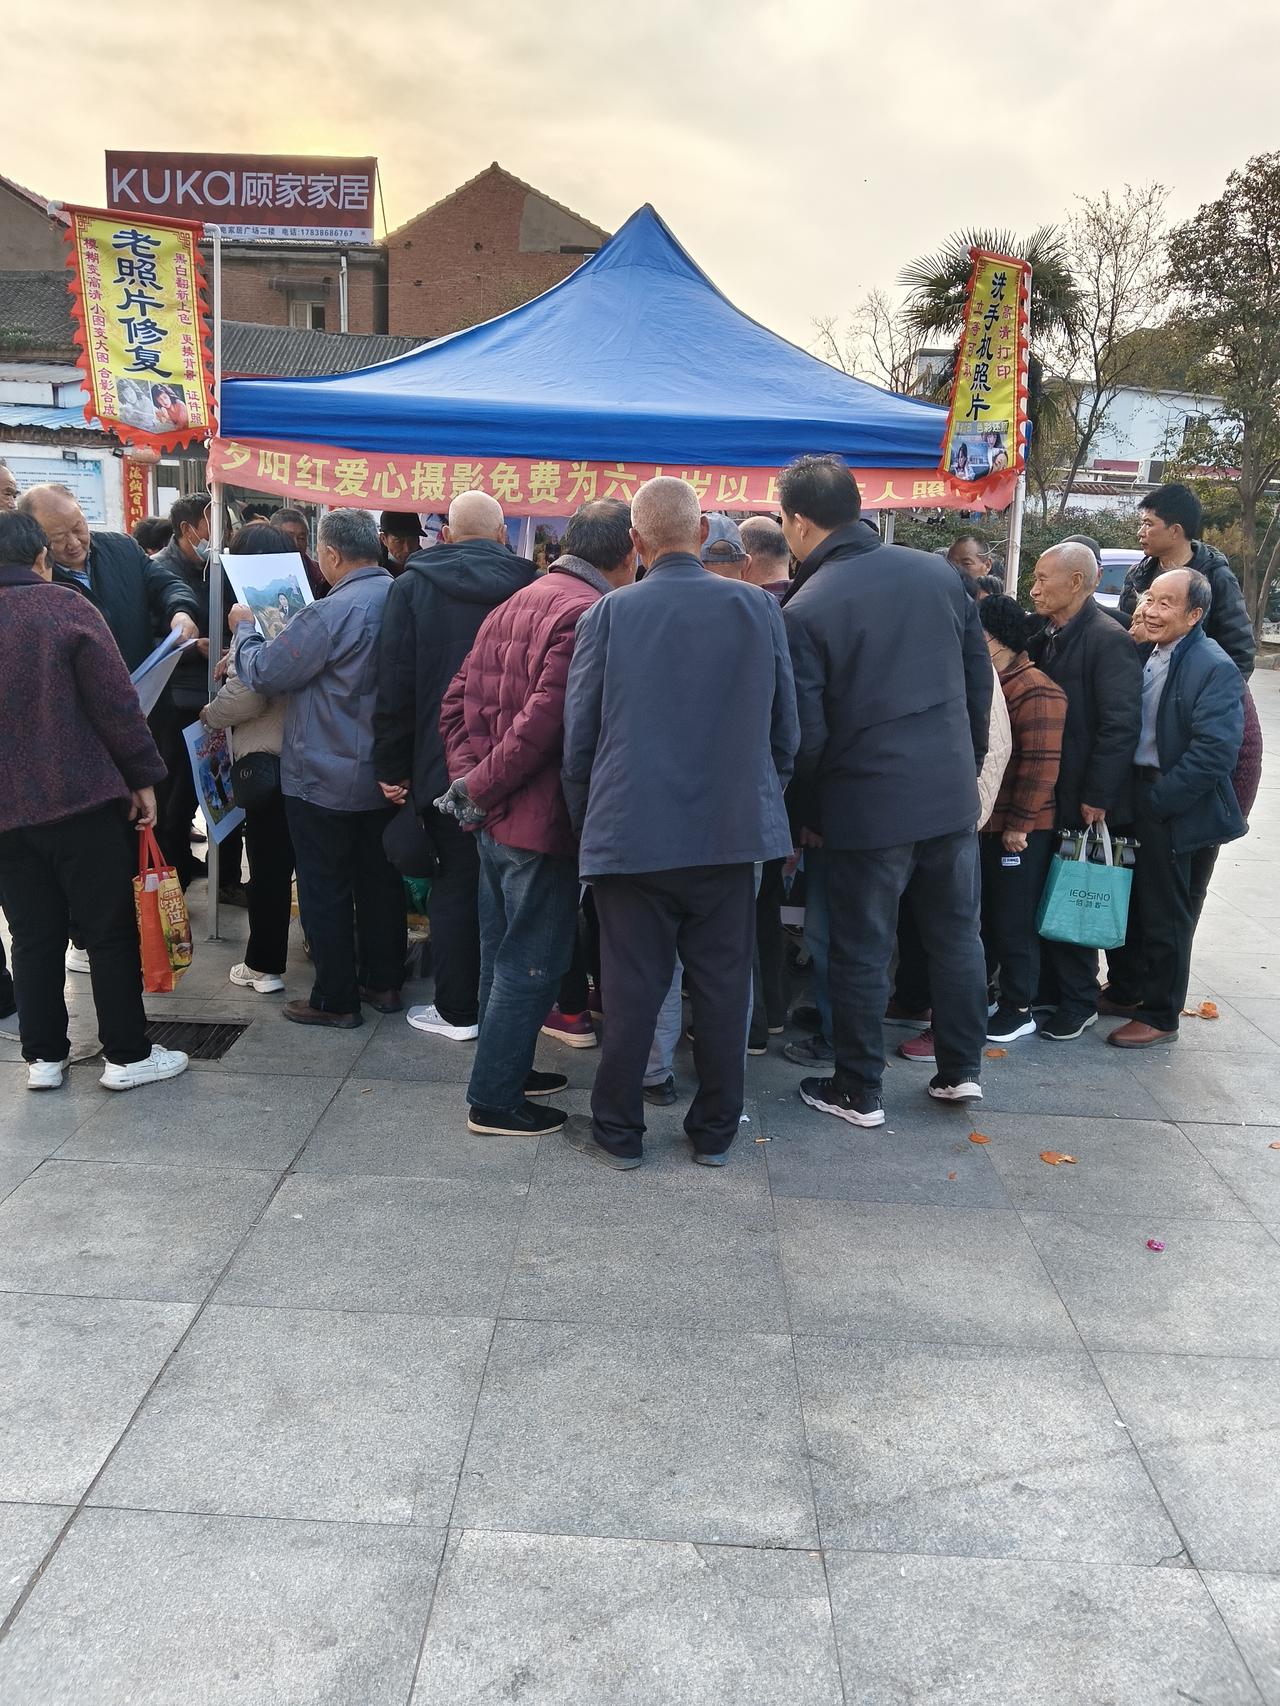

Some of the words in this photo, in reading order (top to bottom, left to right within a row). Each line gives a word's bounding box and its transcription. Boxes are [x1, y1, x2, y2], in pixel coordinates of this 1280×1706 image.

[240, 172, 370, 210] 顾家家居
[83, 237, 102, 301] 模糊变高清
[173, 252, 193, 326] 黑白翻新上色
[90, 302, 110, 364] 小图变大图
[112, 228, 173, 379] 老照片修复
[180, 333, 197, 382] 更换背景
[965, 271, 1008, 421] 洗手机照片
[996, 304, 1013, 381] 高清打印
[97, 366, 118, 417] 合影合成
[186, 389, 203, 426] 证件照
